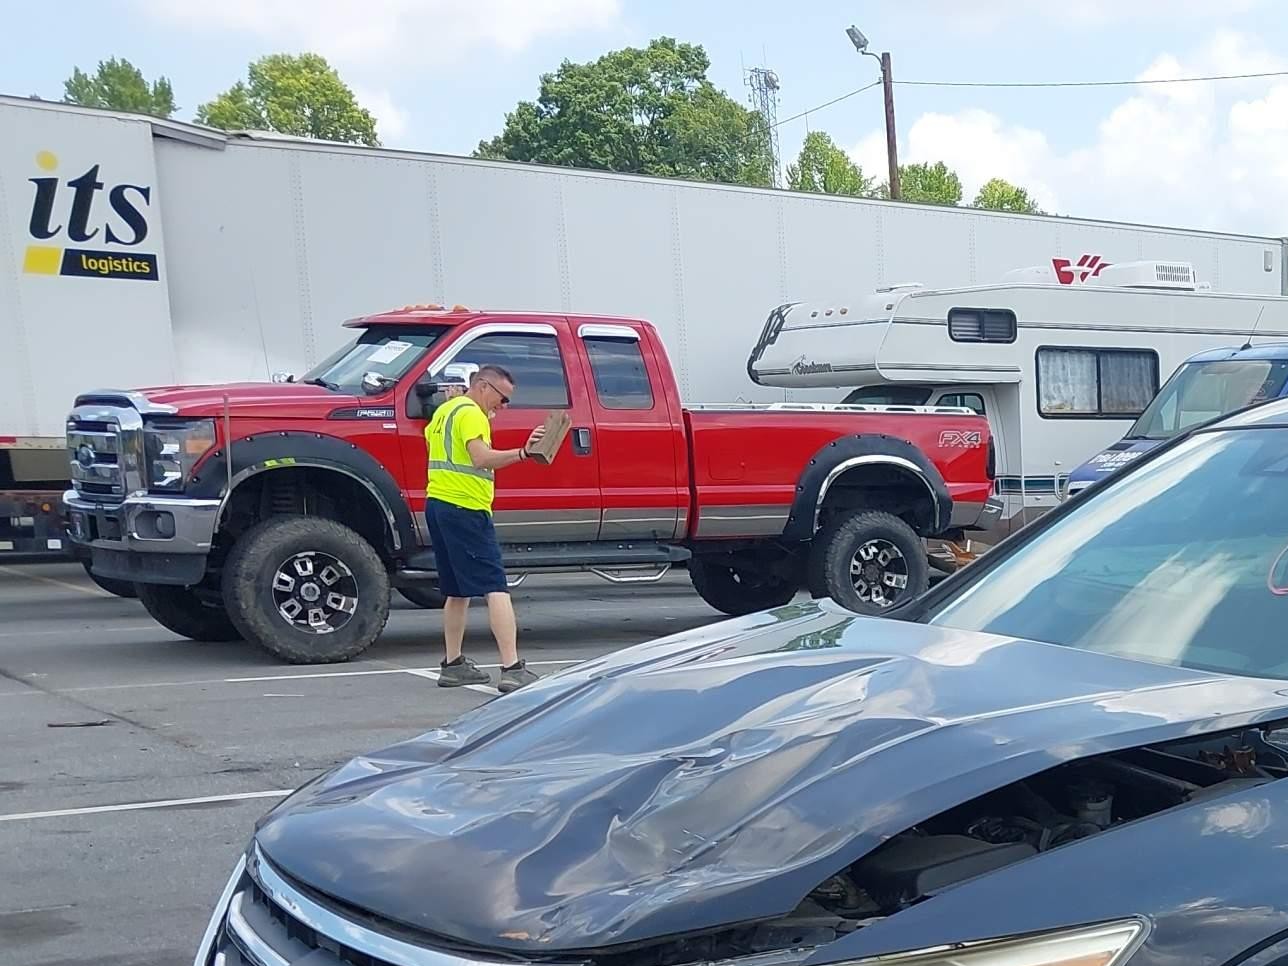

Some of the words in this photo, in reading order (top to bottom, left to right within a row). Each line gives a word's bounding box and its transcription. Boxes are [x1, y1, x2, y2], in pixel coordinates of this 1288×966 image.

[28, 150, 151, 246] its
[81, 254, 151, 274] logistics
[938, 430, 982, 445] FX4
